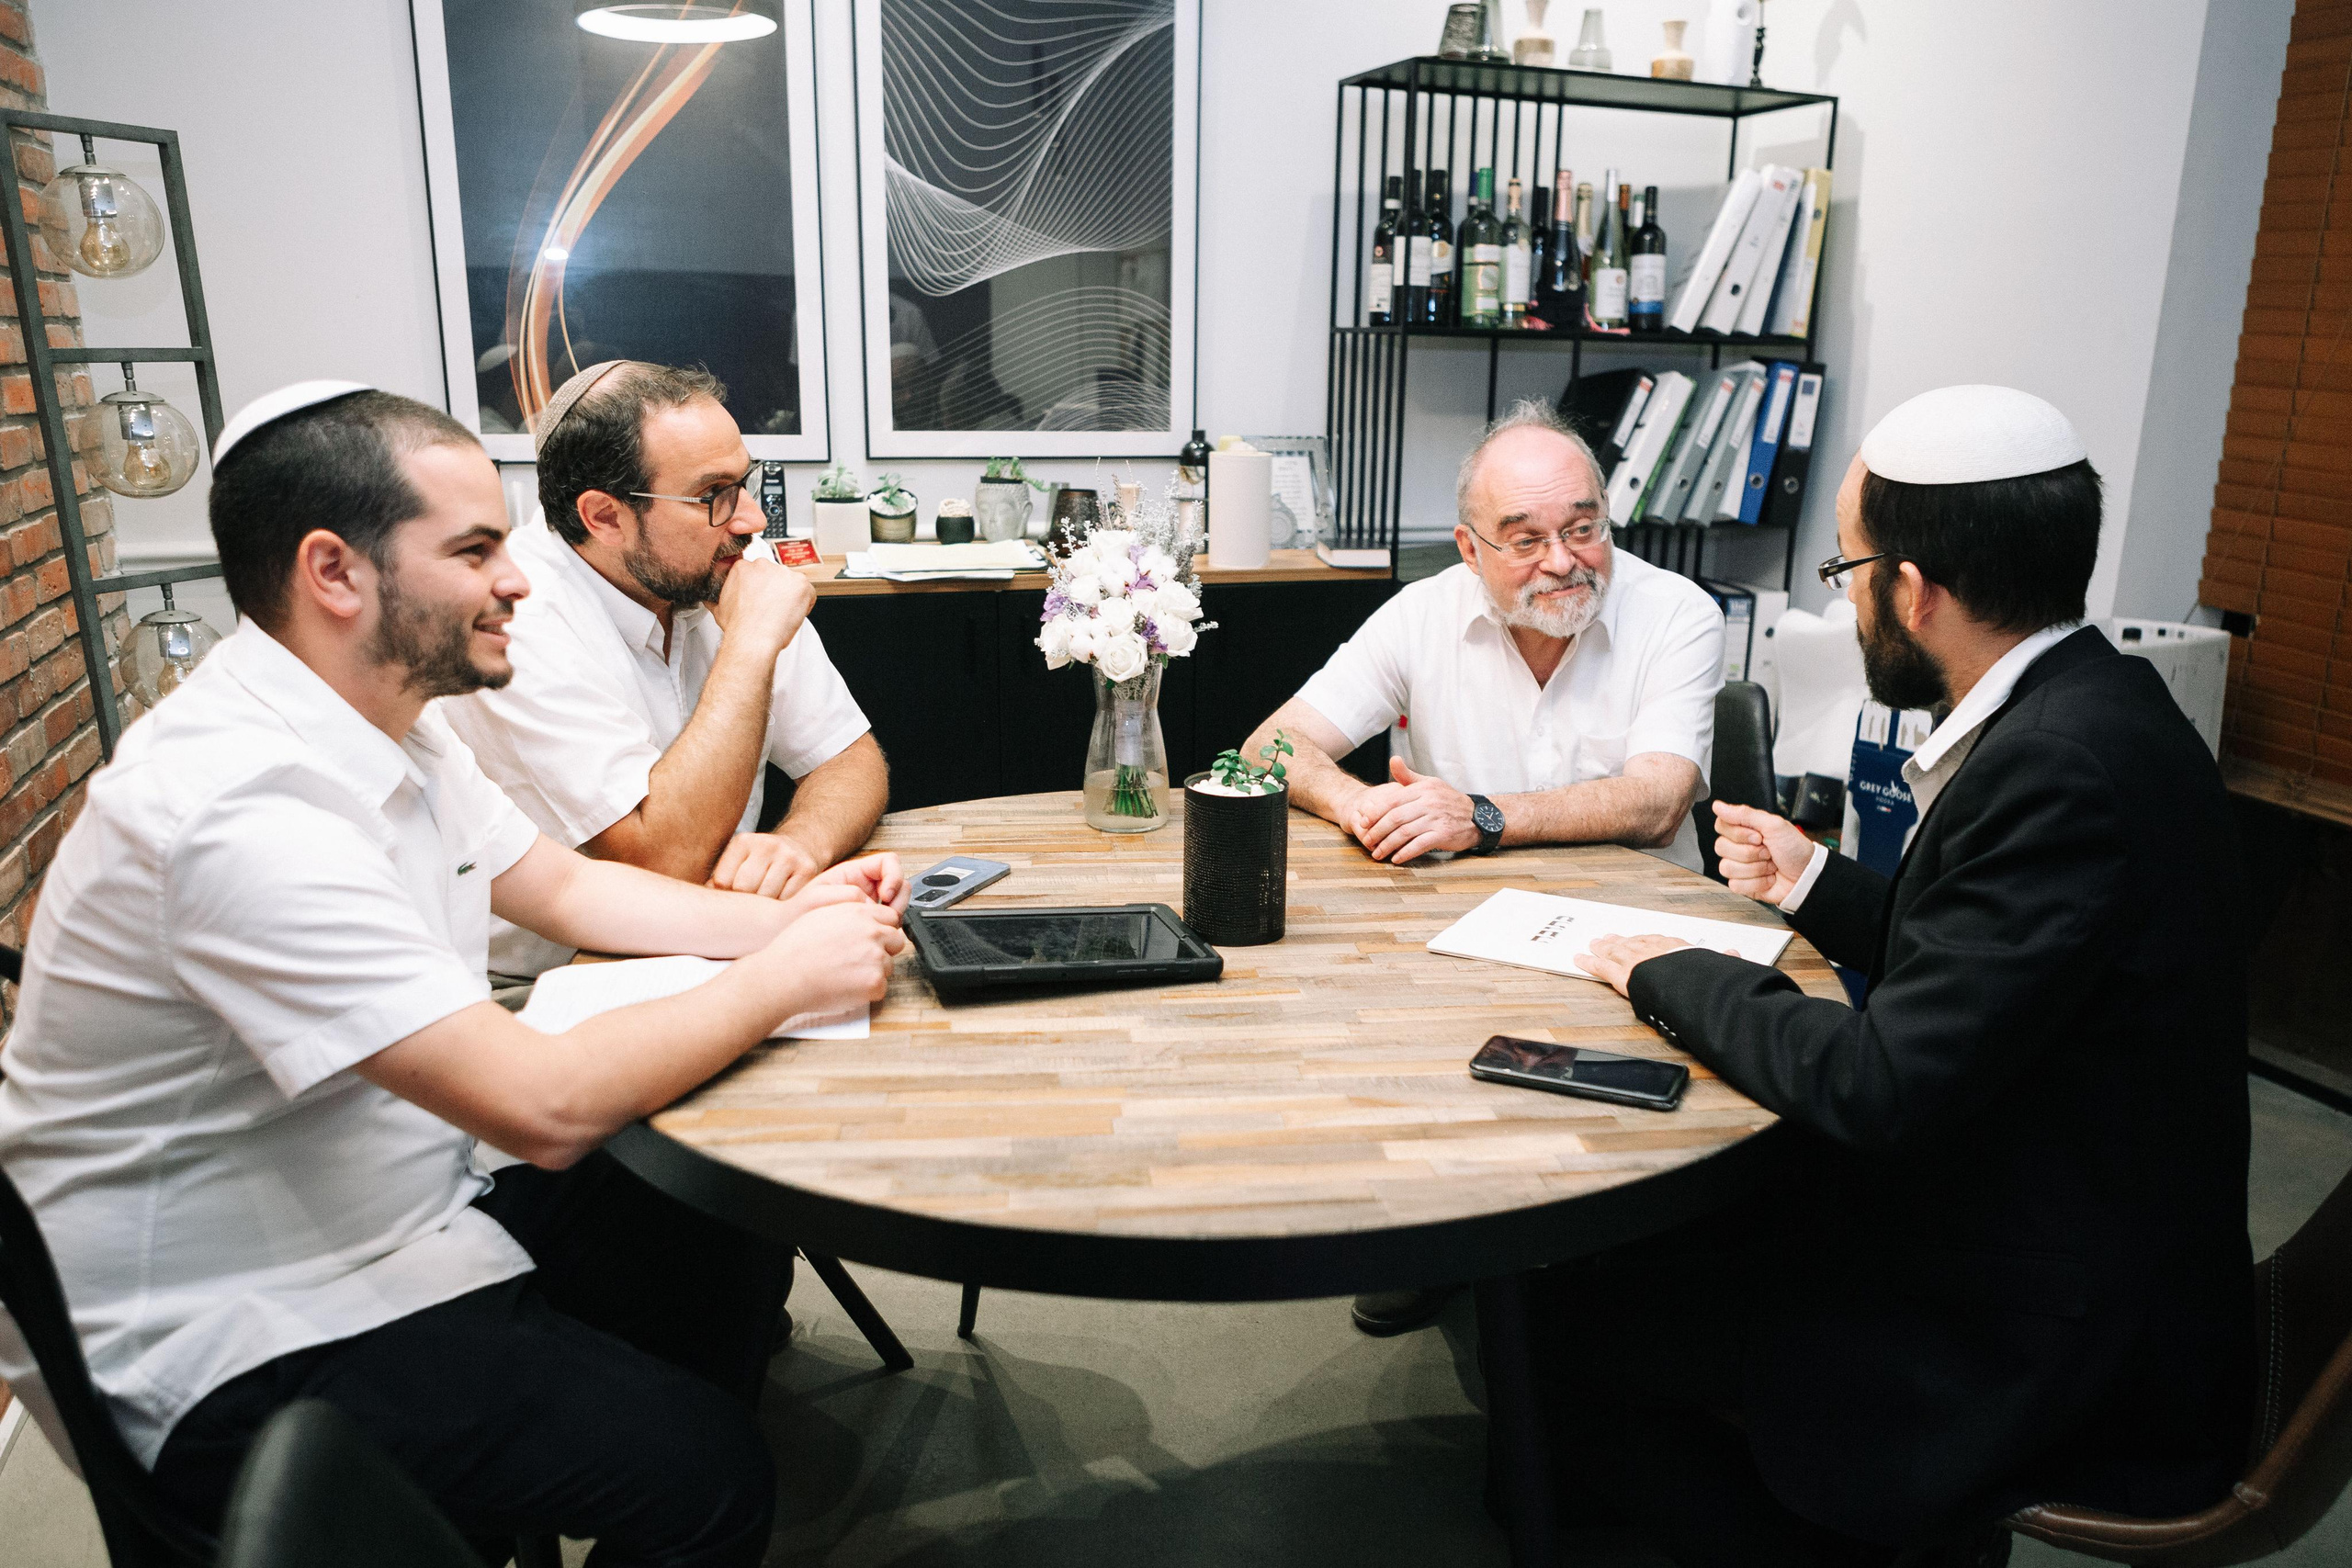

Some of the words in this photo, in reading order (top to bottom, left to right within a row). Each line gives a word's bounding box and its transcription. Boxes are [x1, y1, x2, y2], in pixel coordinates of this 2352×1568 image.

[1860, 781, 1881, 793] GREY
[1883, 785, 1911, 802] GOOSE
[1531, 915, 1575, 943] כתובה
